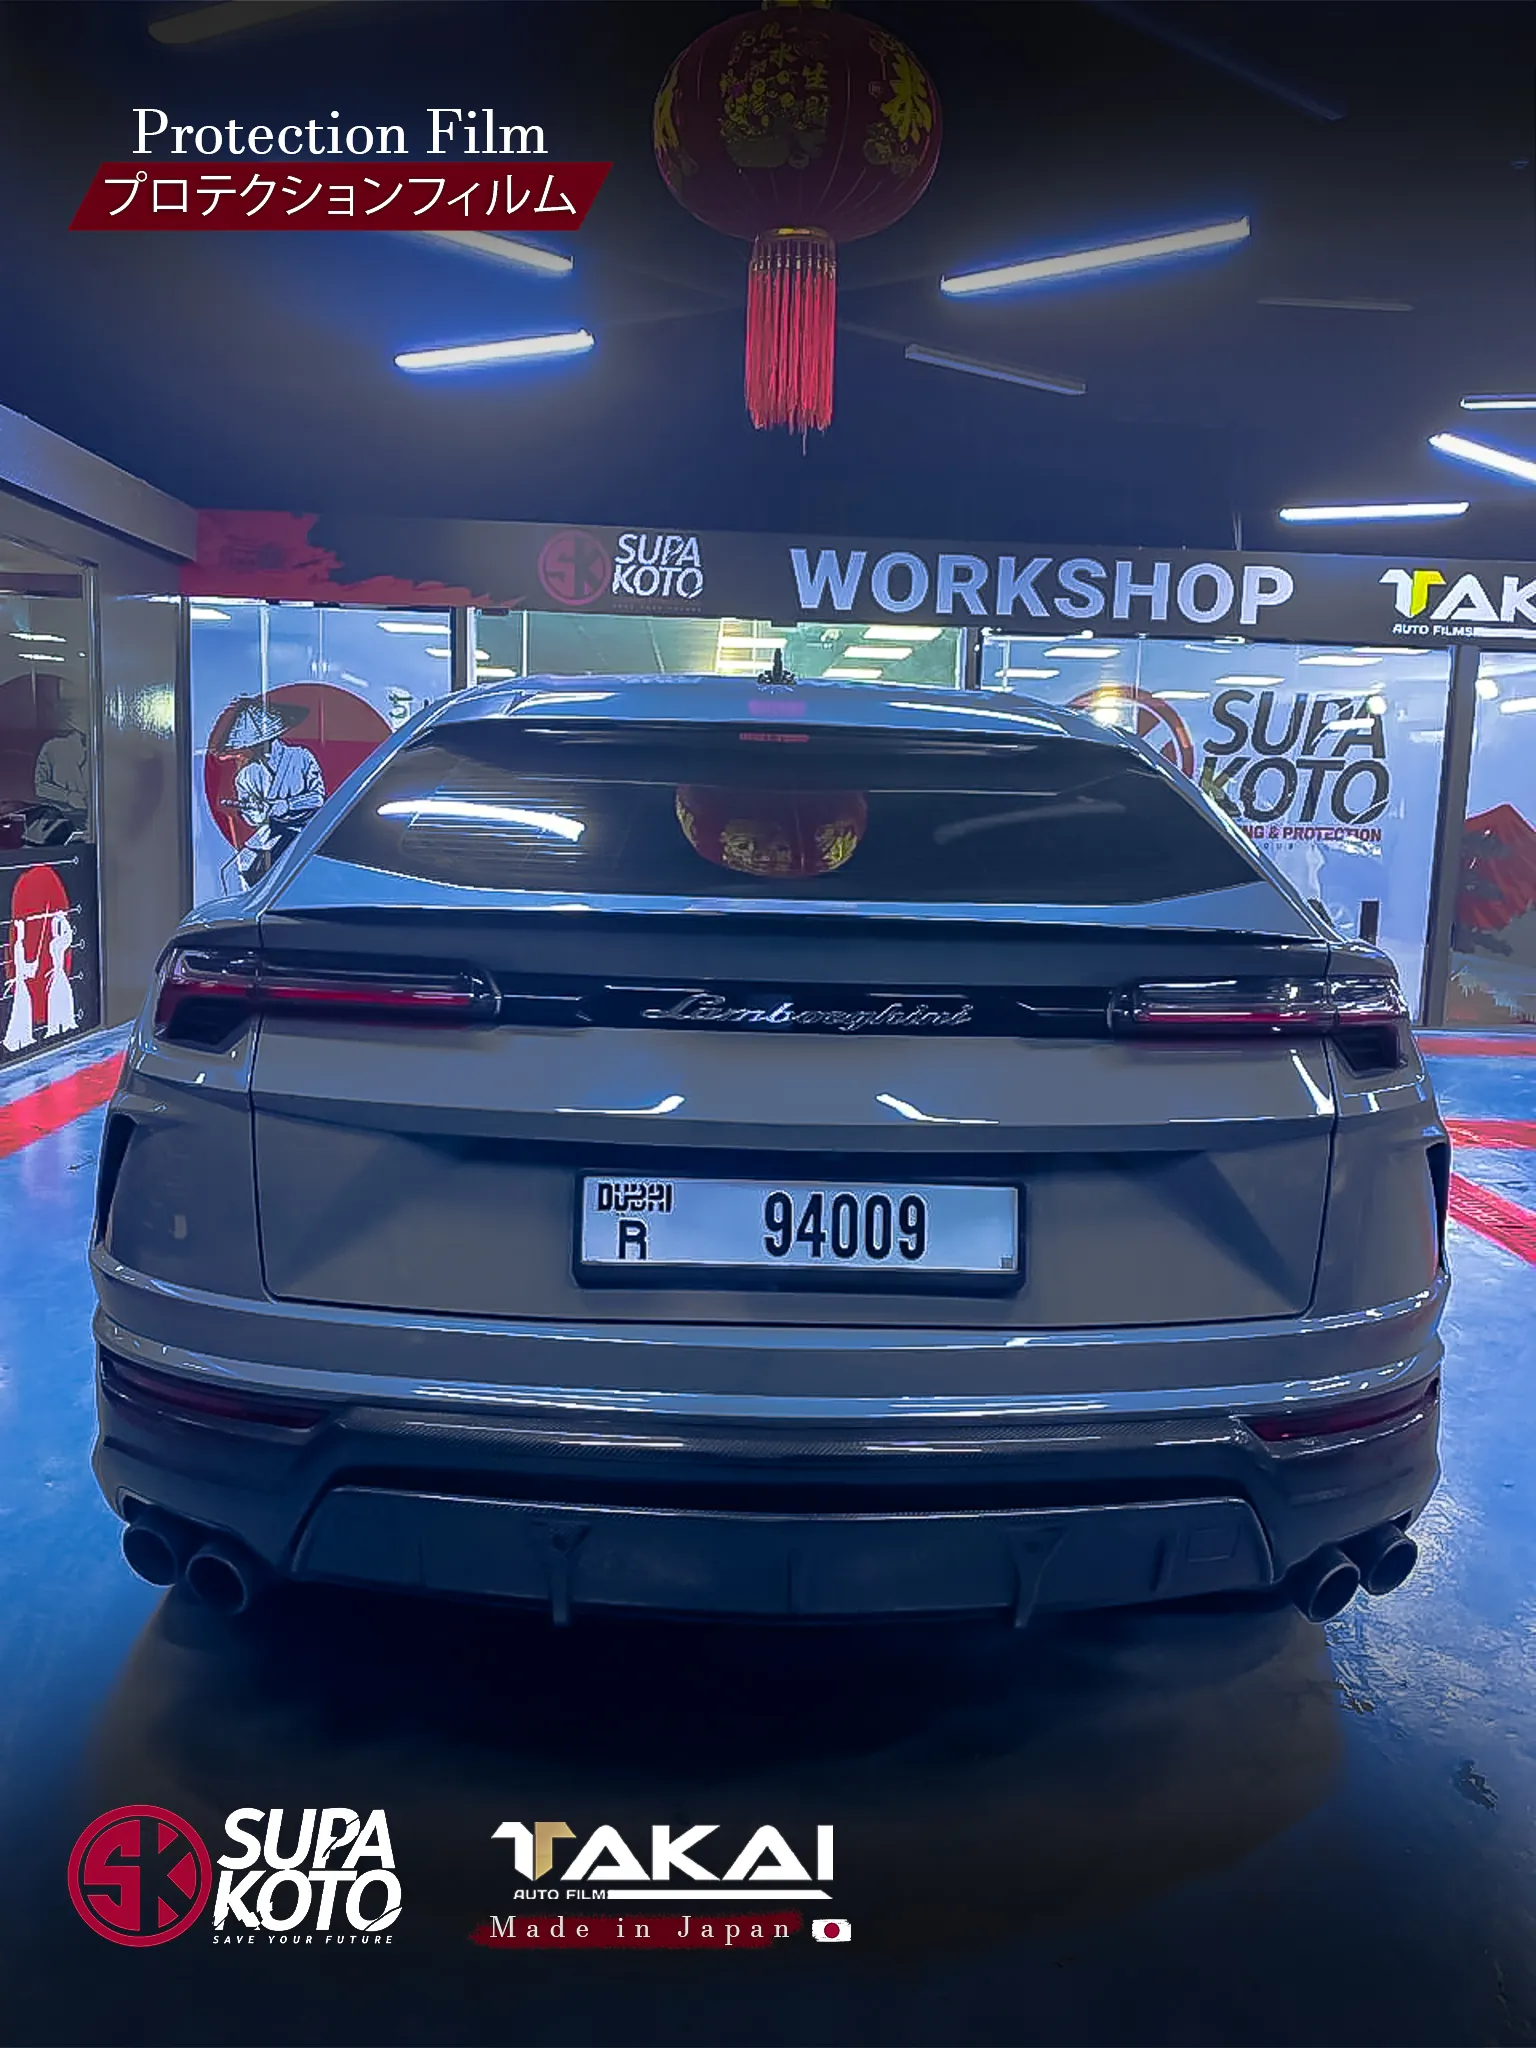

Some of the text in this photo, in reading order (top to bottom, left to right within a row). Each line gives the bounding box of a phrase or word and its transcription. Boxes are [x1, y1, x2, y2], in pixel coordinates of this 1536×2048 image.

[614, 533, 701, 567] SUPA
[612, 564, 704, 600] KOTO
[790, 547, 1295, 625] WORKSHOP
[1392, 624, 1429, 635] AUTO
[1203, 689, 1386, 759] SUPA
[1199, 756, 1390, 825] KOTO
[1283, 827, 1382, 842] PROTECTION
[642, 993, 974, 1031] Lamborghini
[598, 1182, 673, 1213] DUBAI
[619, 1192, 926, 1260] R 94009
